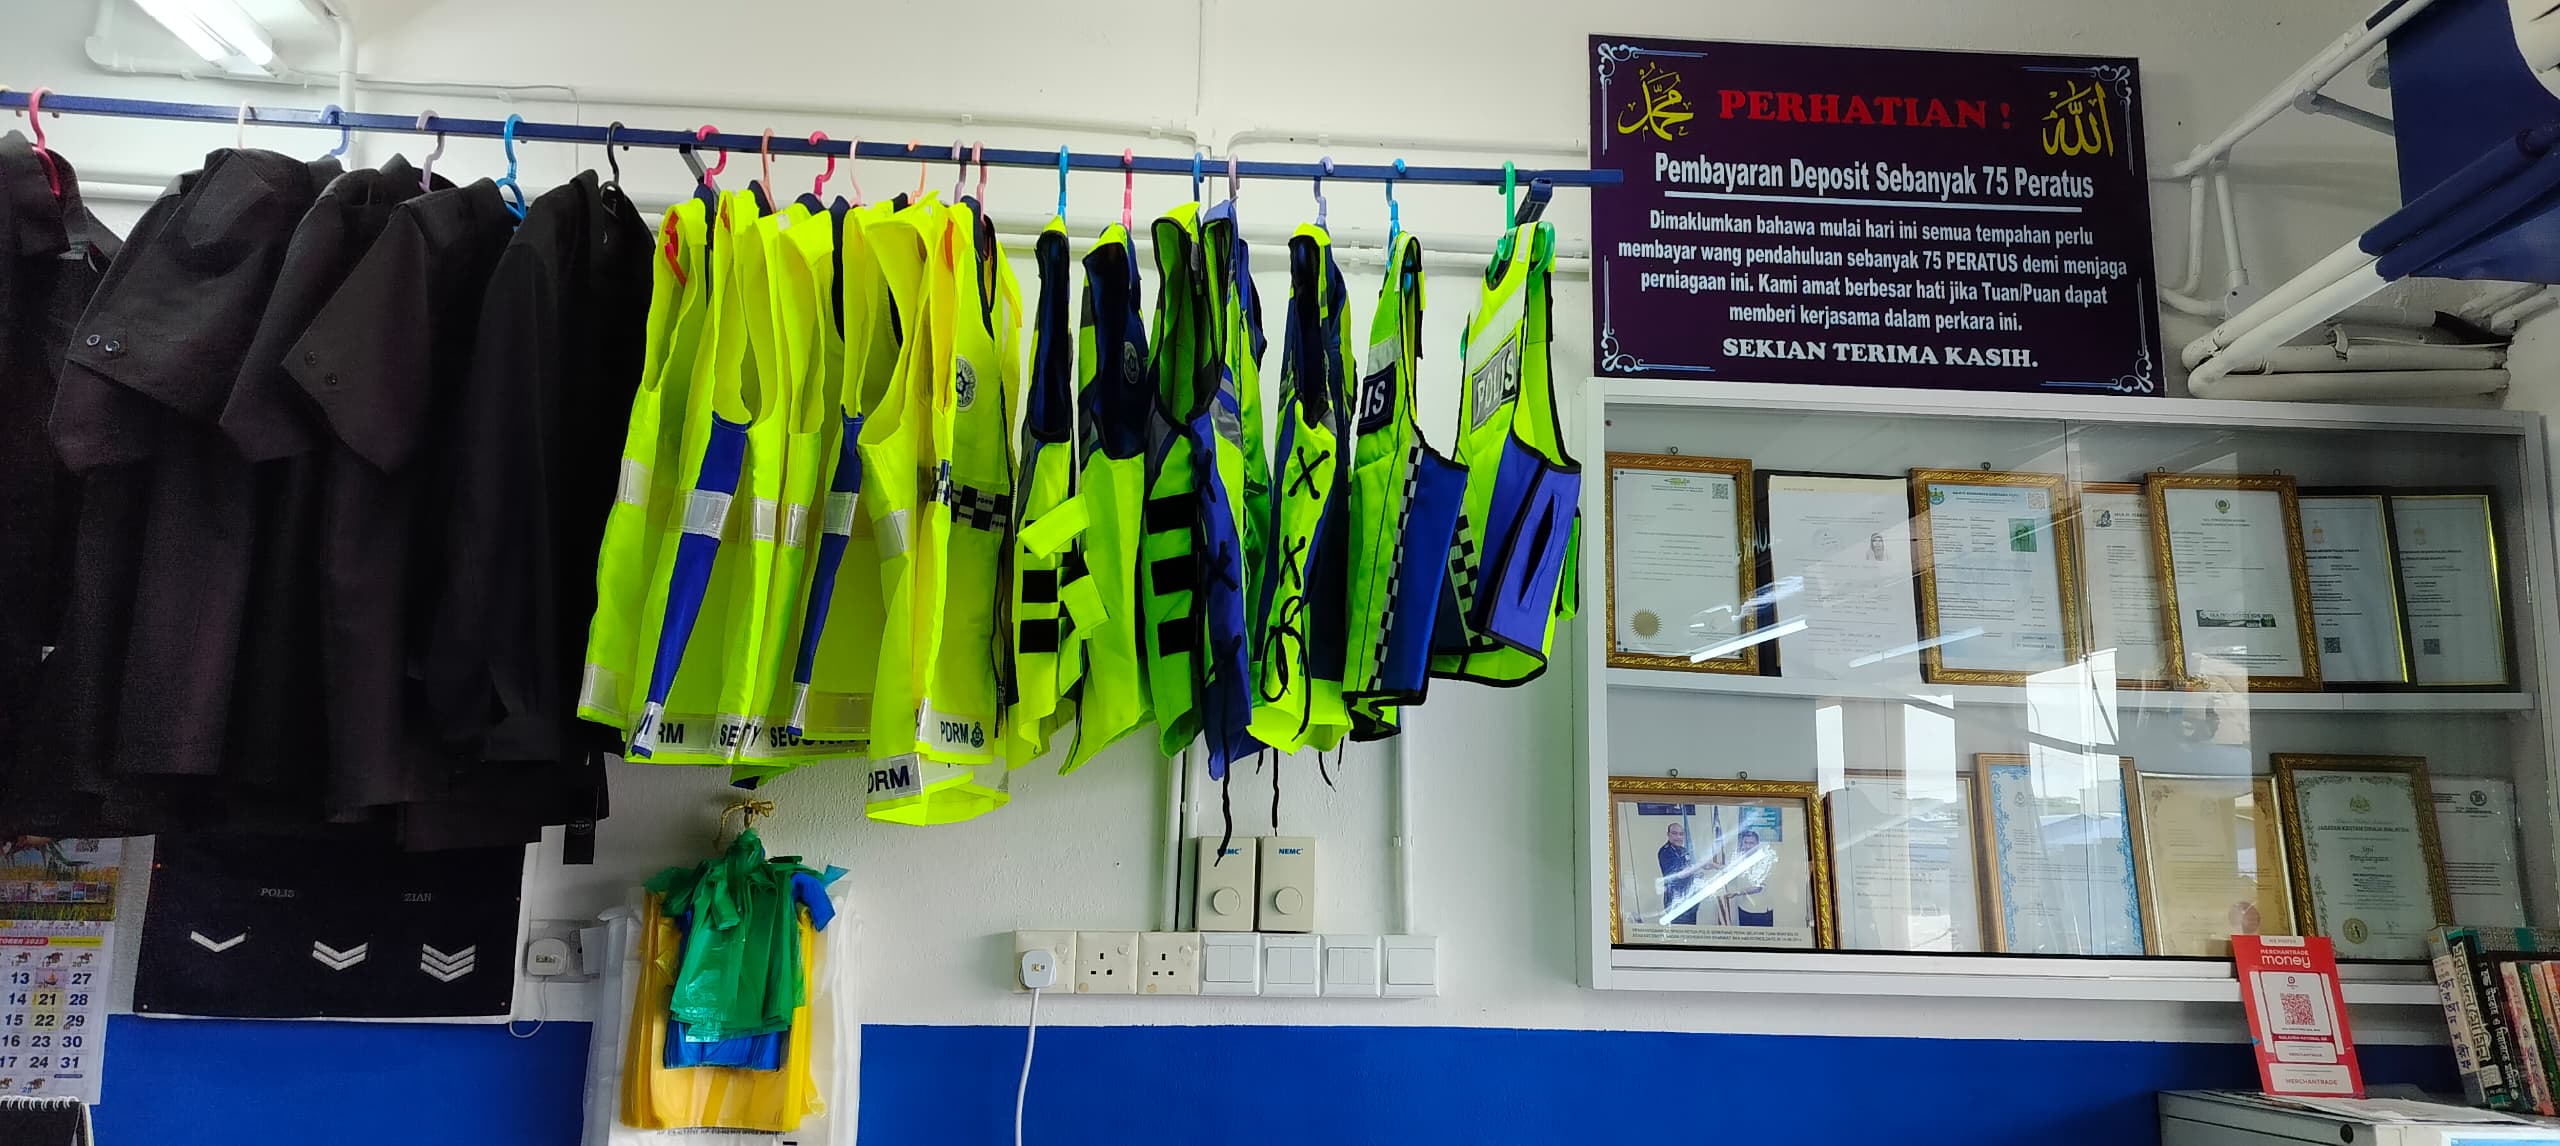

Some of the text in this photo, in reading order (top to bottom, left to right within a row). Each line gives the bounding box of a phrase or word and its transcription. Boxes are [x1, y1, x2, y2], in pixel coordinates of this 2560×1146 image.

[1719, 89, 1986, 129] PERHATIAN
[1654, 151, 2095, 201] Pembayaran Deposit Sebanyak 75 Peratus
[1649, 208, 2094, 249] Dimaklumkan bahawa mulai hari ini semua tempahan perlu
[1618, 238, 2128, 280] membayar wang pendahuluan sebanyak 75 PERATUS demi menjaga
[1640, 269, 2109, 307] perniagaan ini. Kami amat berbesar hati jika Tuan/Puan dapat
[1729, 302, 2024, 333] memberi kerjasama dalam perkara ini.
[1721, 337, 2039, 369] SEKIAN TERIMA KASIH.
[1476, 350, 1515, 418] POLIS
[940, 720, 969, 745] PDRM
[1278, 847, 1302, 855] NEMC
[259, 887, 296, 898] POLIS
[2259, 948, 2310, 956] MERCHANTRADE
[2261, 955, 2312, 969] money
[11, 971, 30, 985] 13
[71, 972, 92, 985] 27
[9, 992, 27, 1005] 14
[38, 993, 57, 1006] 21
[68, 993, 89, 1006] 28
[5, 1013, 24, 1026] 15
[34, 1014, 55, 1027] 22
[65, 1014, 85, 1027] 29
[2, 1034, 21, 1047] 16
[31, 1035, 51, 1048] 23
[62, 1036, 83, 1048] 30
[0, 1055, 18, 1068] 17
[29, 1056, 49, 1069] 24
[60, 1056, 80, 1069] 31
[2284, 1078, 2339, 1086] MERCHANTRADE
